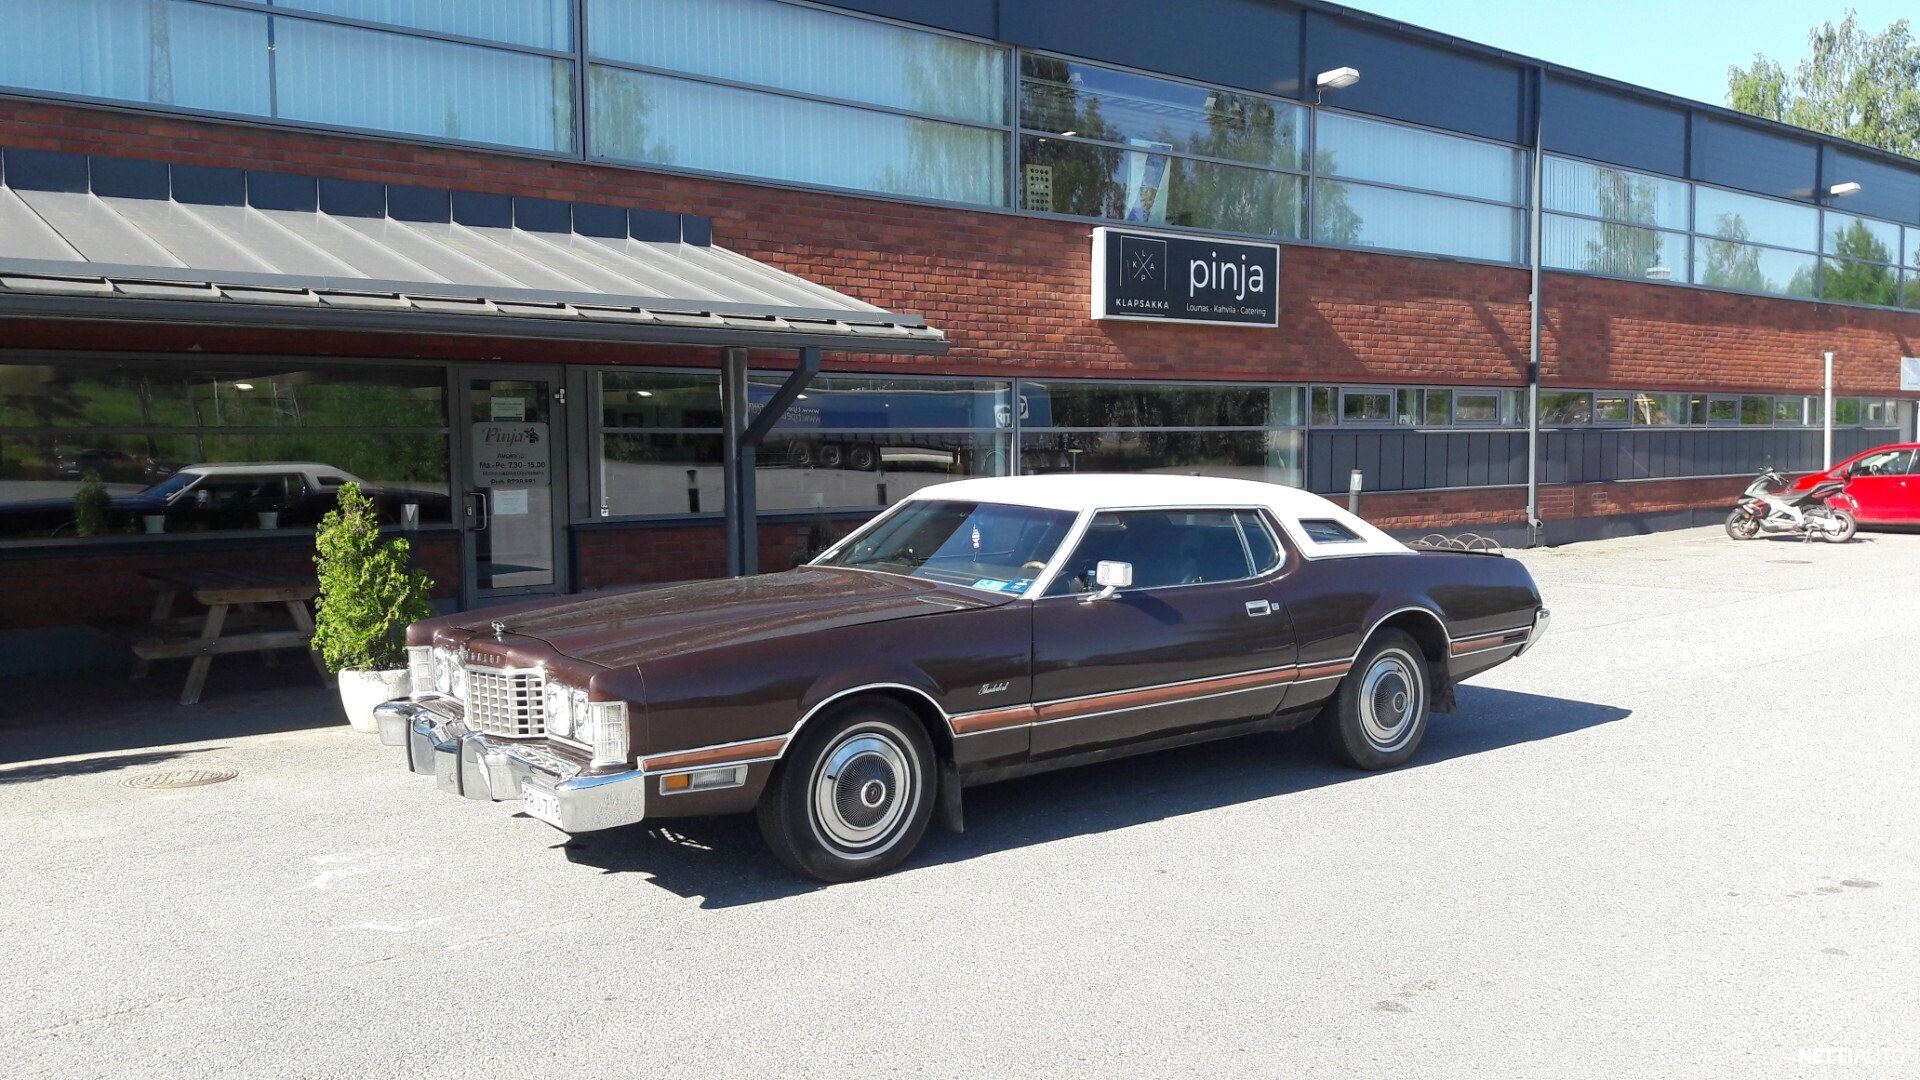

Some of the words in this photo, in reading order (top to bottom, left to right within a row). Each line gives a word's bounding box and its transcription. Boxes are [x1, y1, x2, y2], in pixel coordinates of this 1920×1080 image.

[1189, 251, 1264, 301] pinja
[1115, 298, 1170, 309] KLAPSAKKA
[1186, 303, 1209, 312] Lounas
[1213, 304, 1236, 314] Kahvila
[1240, 306, 1267, 317] Catering
[482, 427, 525, 447] Pinja
